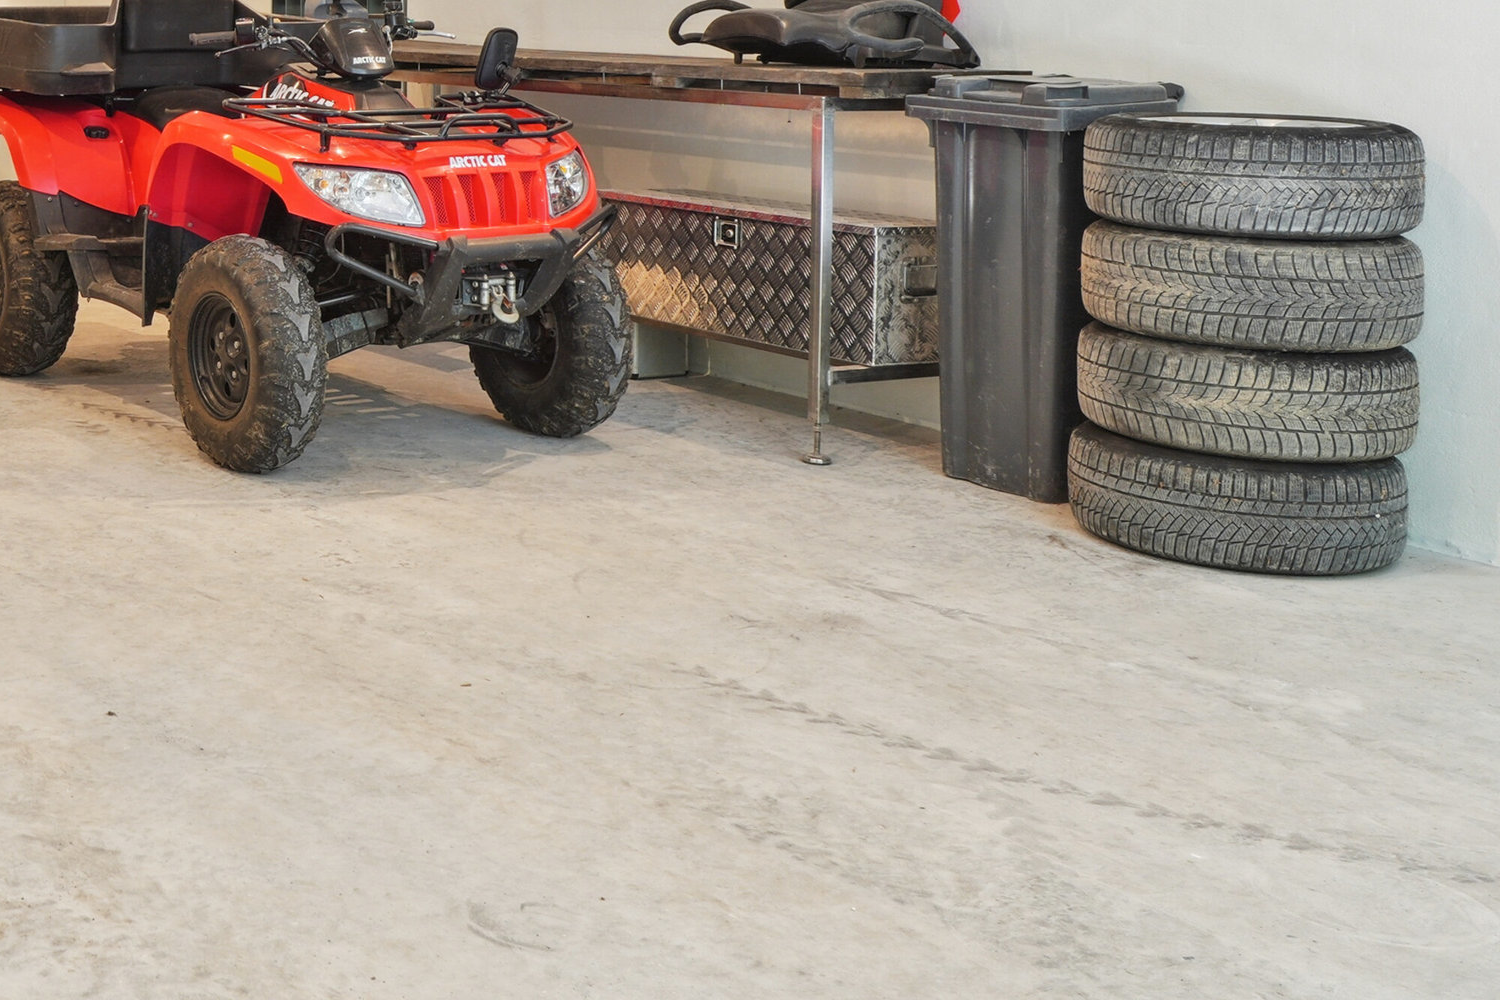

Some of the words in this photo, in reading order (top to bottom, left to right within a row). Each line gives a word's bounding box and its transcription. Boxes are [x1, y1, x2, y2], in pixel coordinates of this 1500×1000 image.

[352, 56, 375, 65] ARCTIC
[375, 56, 387, 64] CAT
[269, 81, 309, 101] ARCTIC
[449, 155, 487, 169] ARCTIC
[486, 154, 507, 167] CAT
